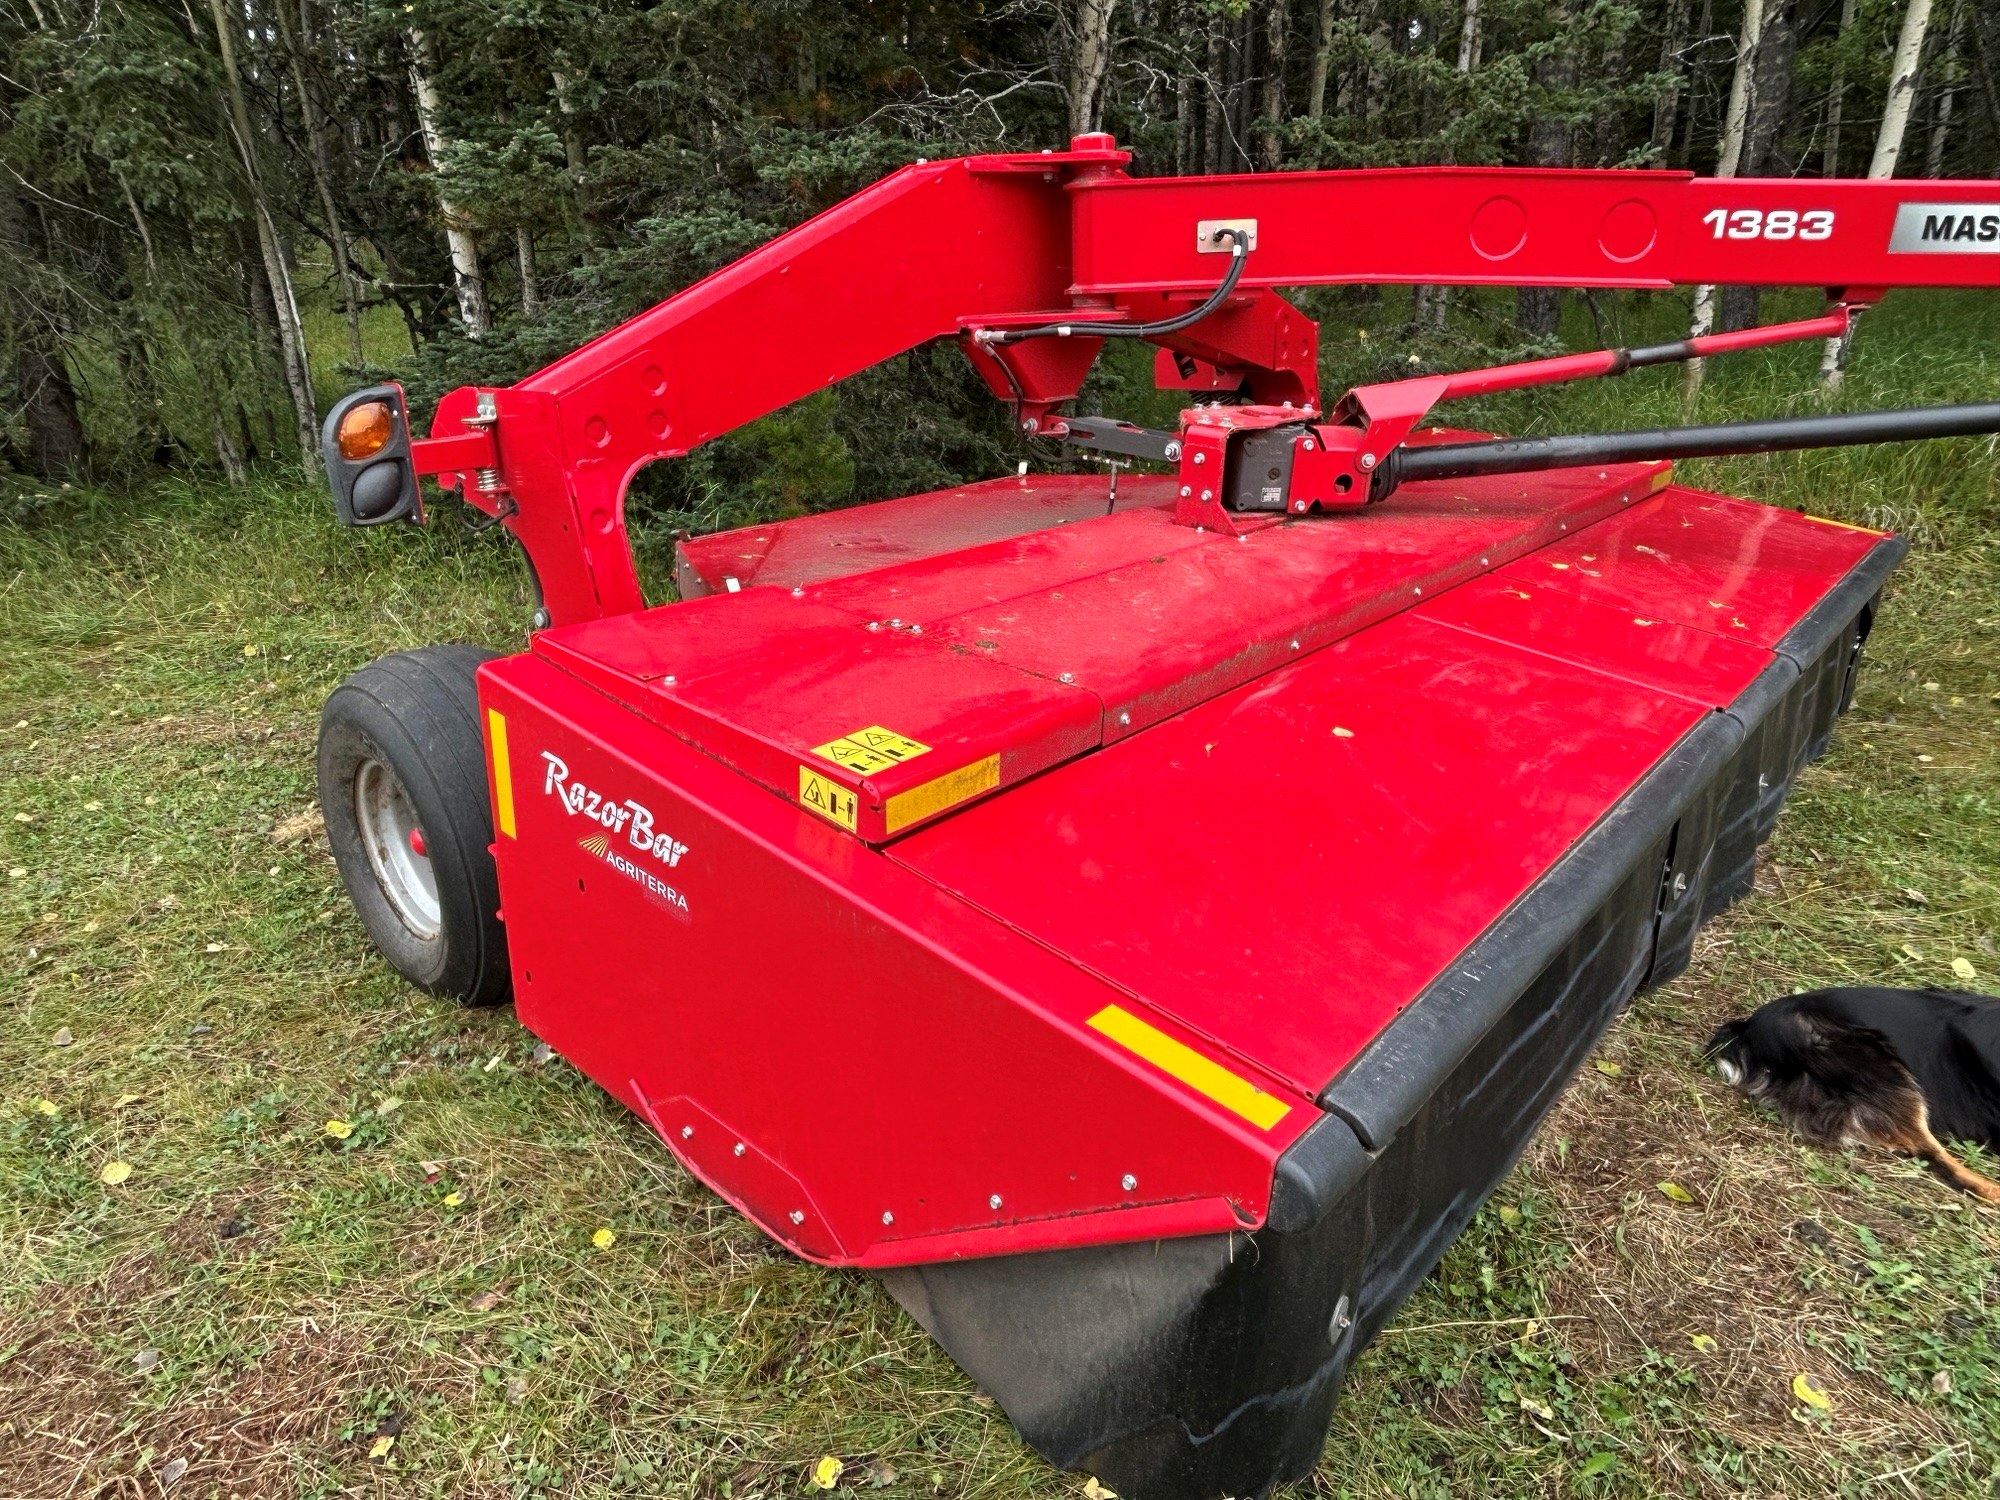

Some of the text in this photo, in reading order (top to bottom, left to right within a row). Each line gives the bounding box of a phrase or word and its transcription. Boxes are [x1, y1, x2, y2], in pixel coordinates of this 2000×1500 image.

[1703, 209, 1835, 240] 1383
[1921, 214, 2000, 241] MAS
[606, 850, 689, 912] AGRITERRA
